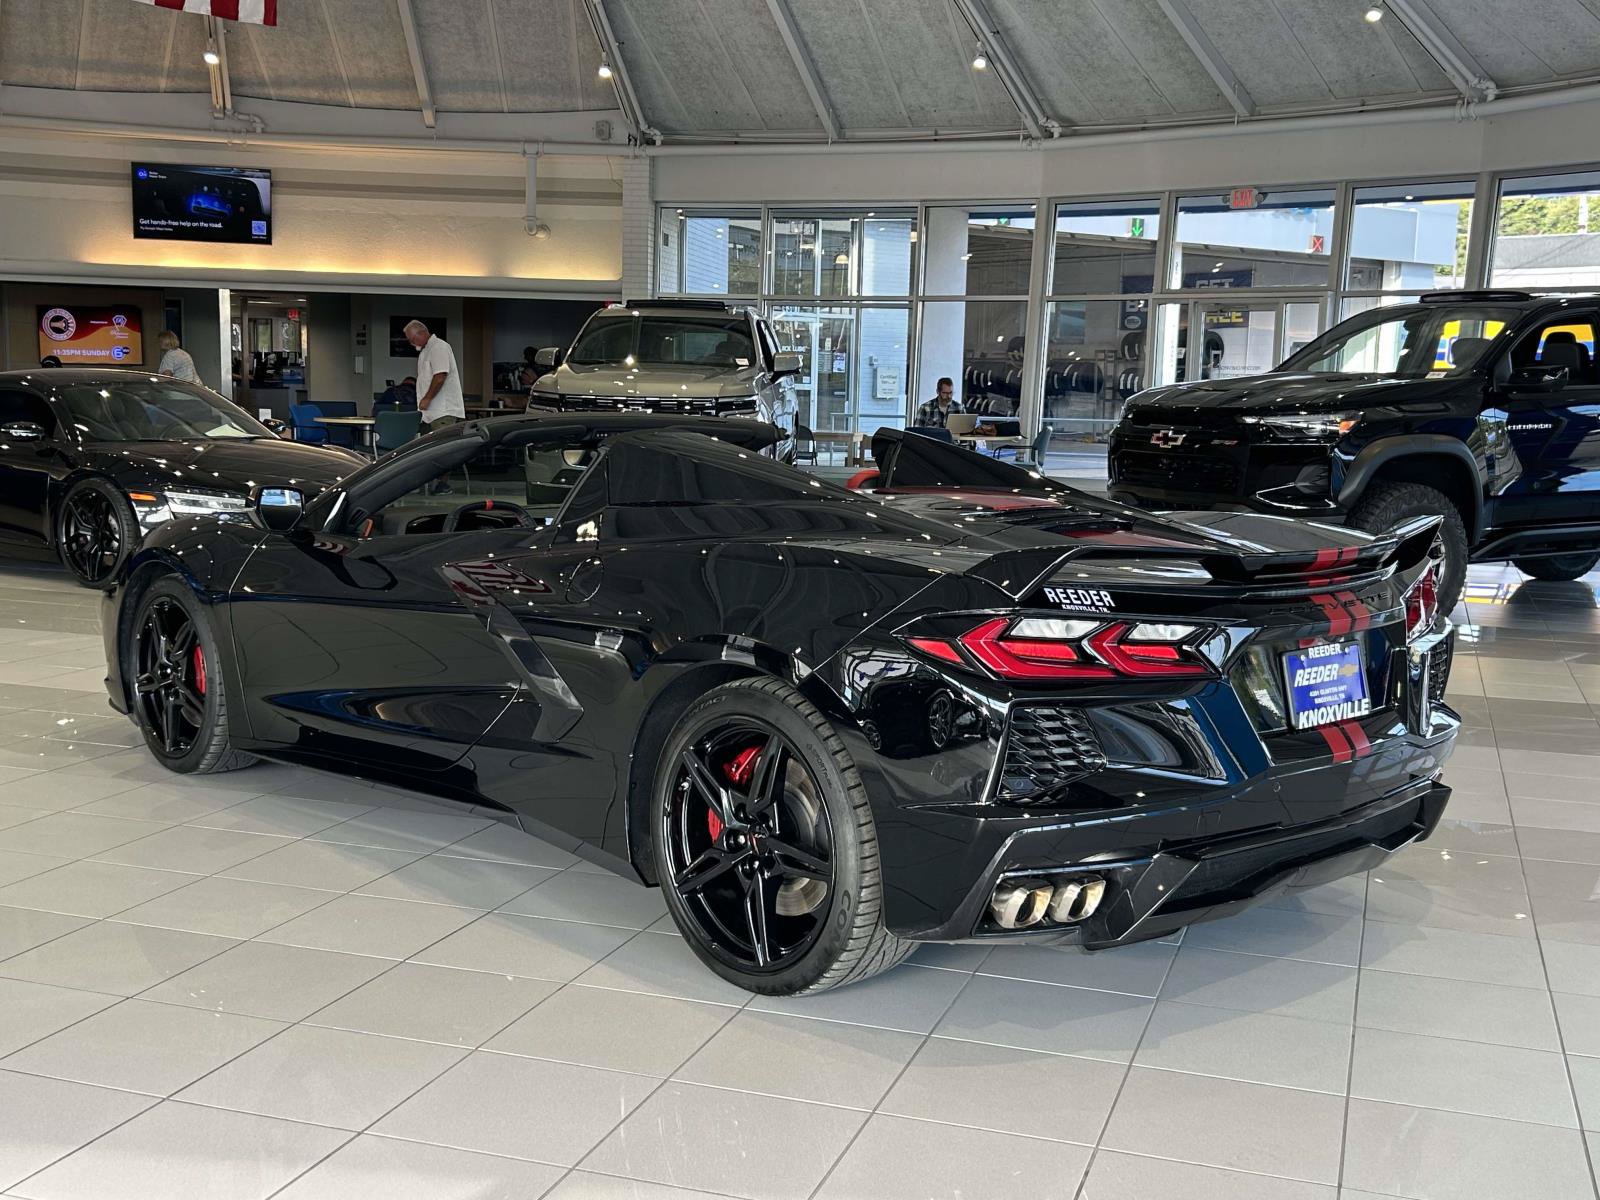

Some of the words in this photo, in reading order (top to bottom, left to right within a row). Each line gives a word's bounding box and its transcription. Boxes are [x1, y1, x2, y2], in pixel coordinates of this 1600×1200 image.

[82, 349, 110, 357] SUNDAY
[1043, 587, 1116, 607] REEDER
[1269, 592, 1389, 615] CORVETTE
[1061, 604, 1099, 613] KNOXVILLE,
[1308, 643, 1342, 659] REEDER
[1294, 664, 1340, 688] REEDER
[1299, 698, 1370, 729] KNOXVILLE
